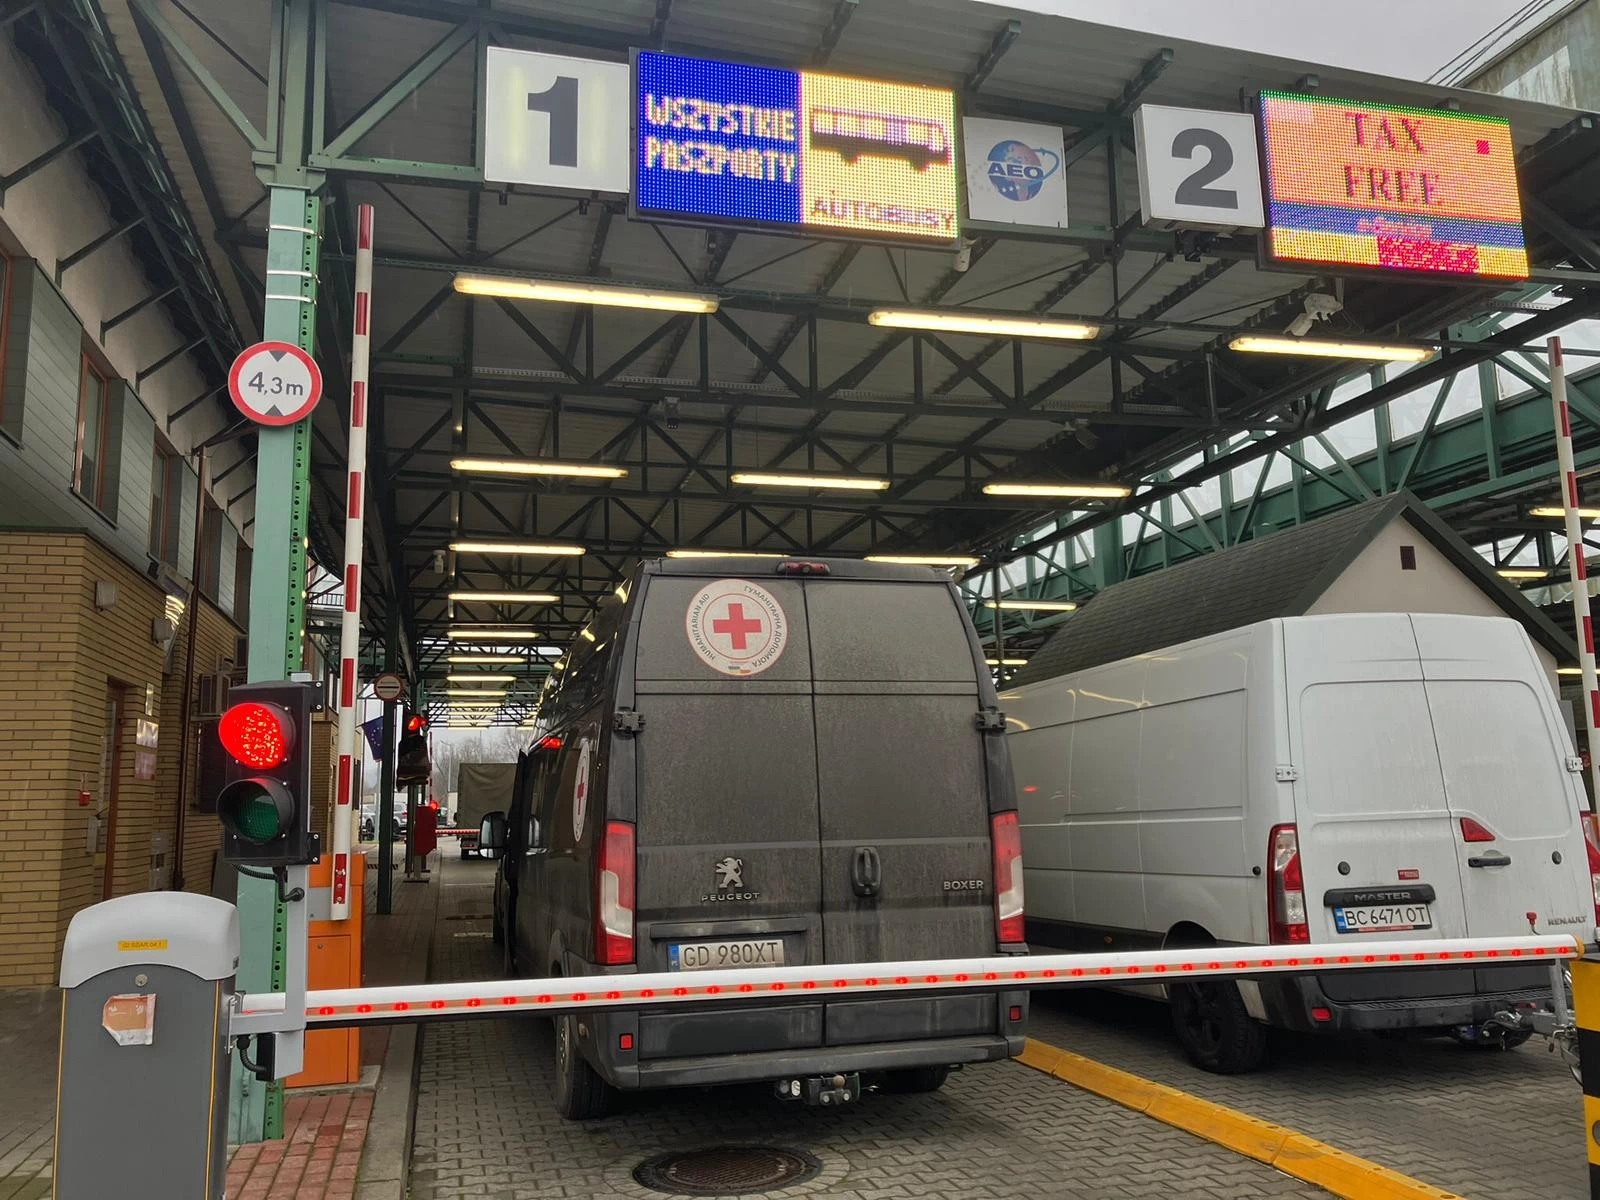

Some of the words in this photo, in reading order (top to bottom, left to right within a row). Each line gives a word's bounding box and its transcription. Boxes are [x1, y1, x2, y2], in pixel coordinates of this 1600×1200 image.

[527, 76, 578, 168] 1
[1344, 111, 1425, 155] TAX
[645, 136, 797, 183] PASZPORTY
[987, 161, 1044, 180] AEO
[1171, 128, 1239, 210] 2
[1344, 164, 1443, 206] FREE
[699, 593, 710, 606] AID
[744, 585, 783, 630] ГУМАНІТАРНА
[690, 604, 716, 661] HUMANITARIAN
[752, 631, 783, 669] ДОПОМОГА
[701, 892, 760, 902] PEUGEOT
[943, 880, 984, 890] BOXER
[1354, 892, 1412, 902] MASTER
[1345, 910, 1369, 926] BC
[1370, 908, 1404, 925] 6471
[1547, 915, 1588, 927] RENAULT
[683, 946, 710, 967] GD
[718, 942, 778, 965] 980XT
